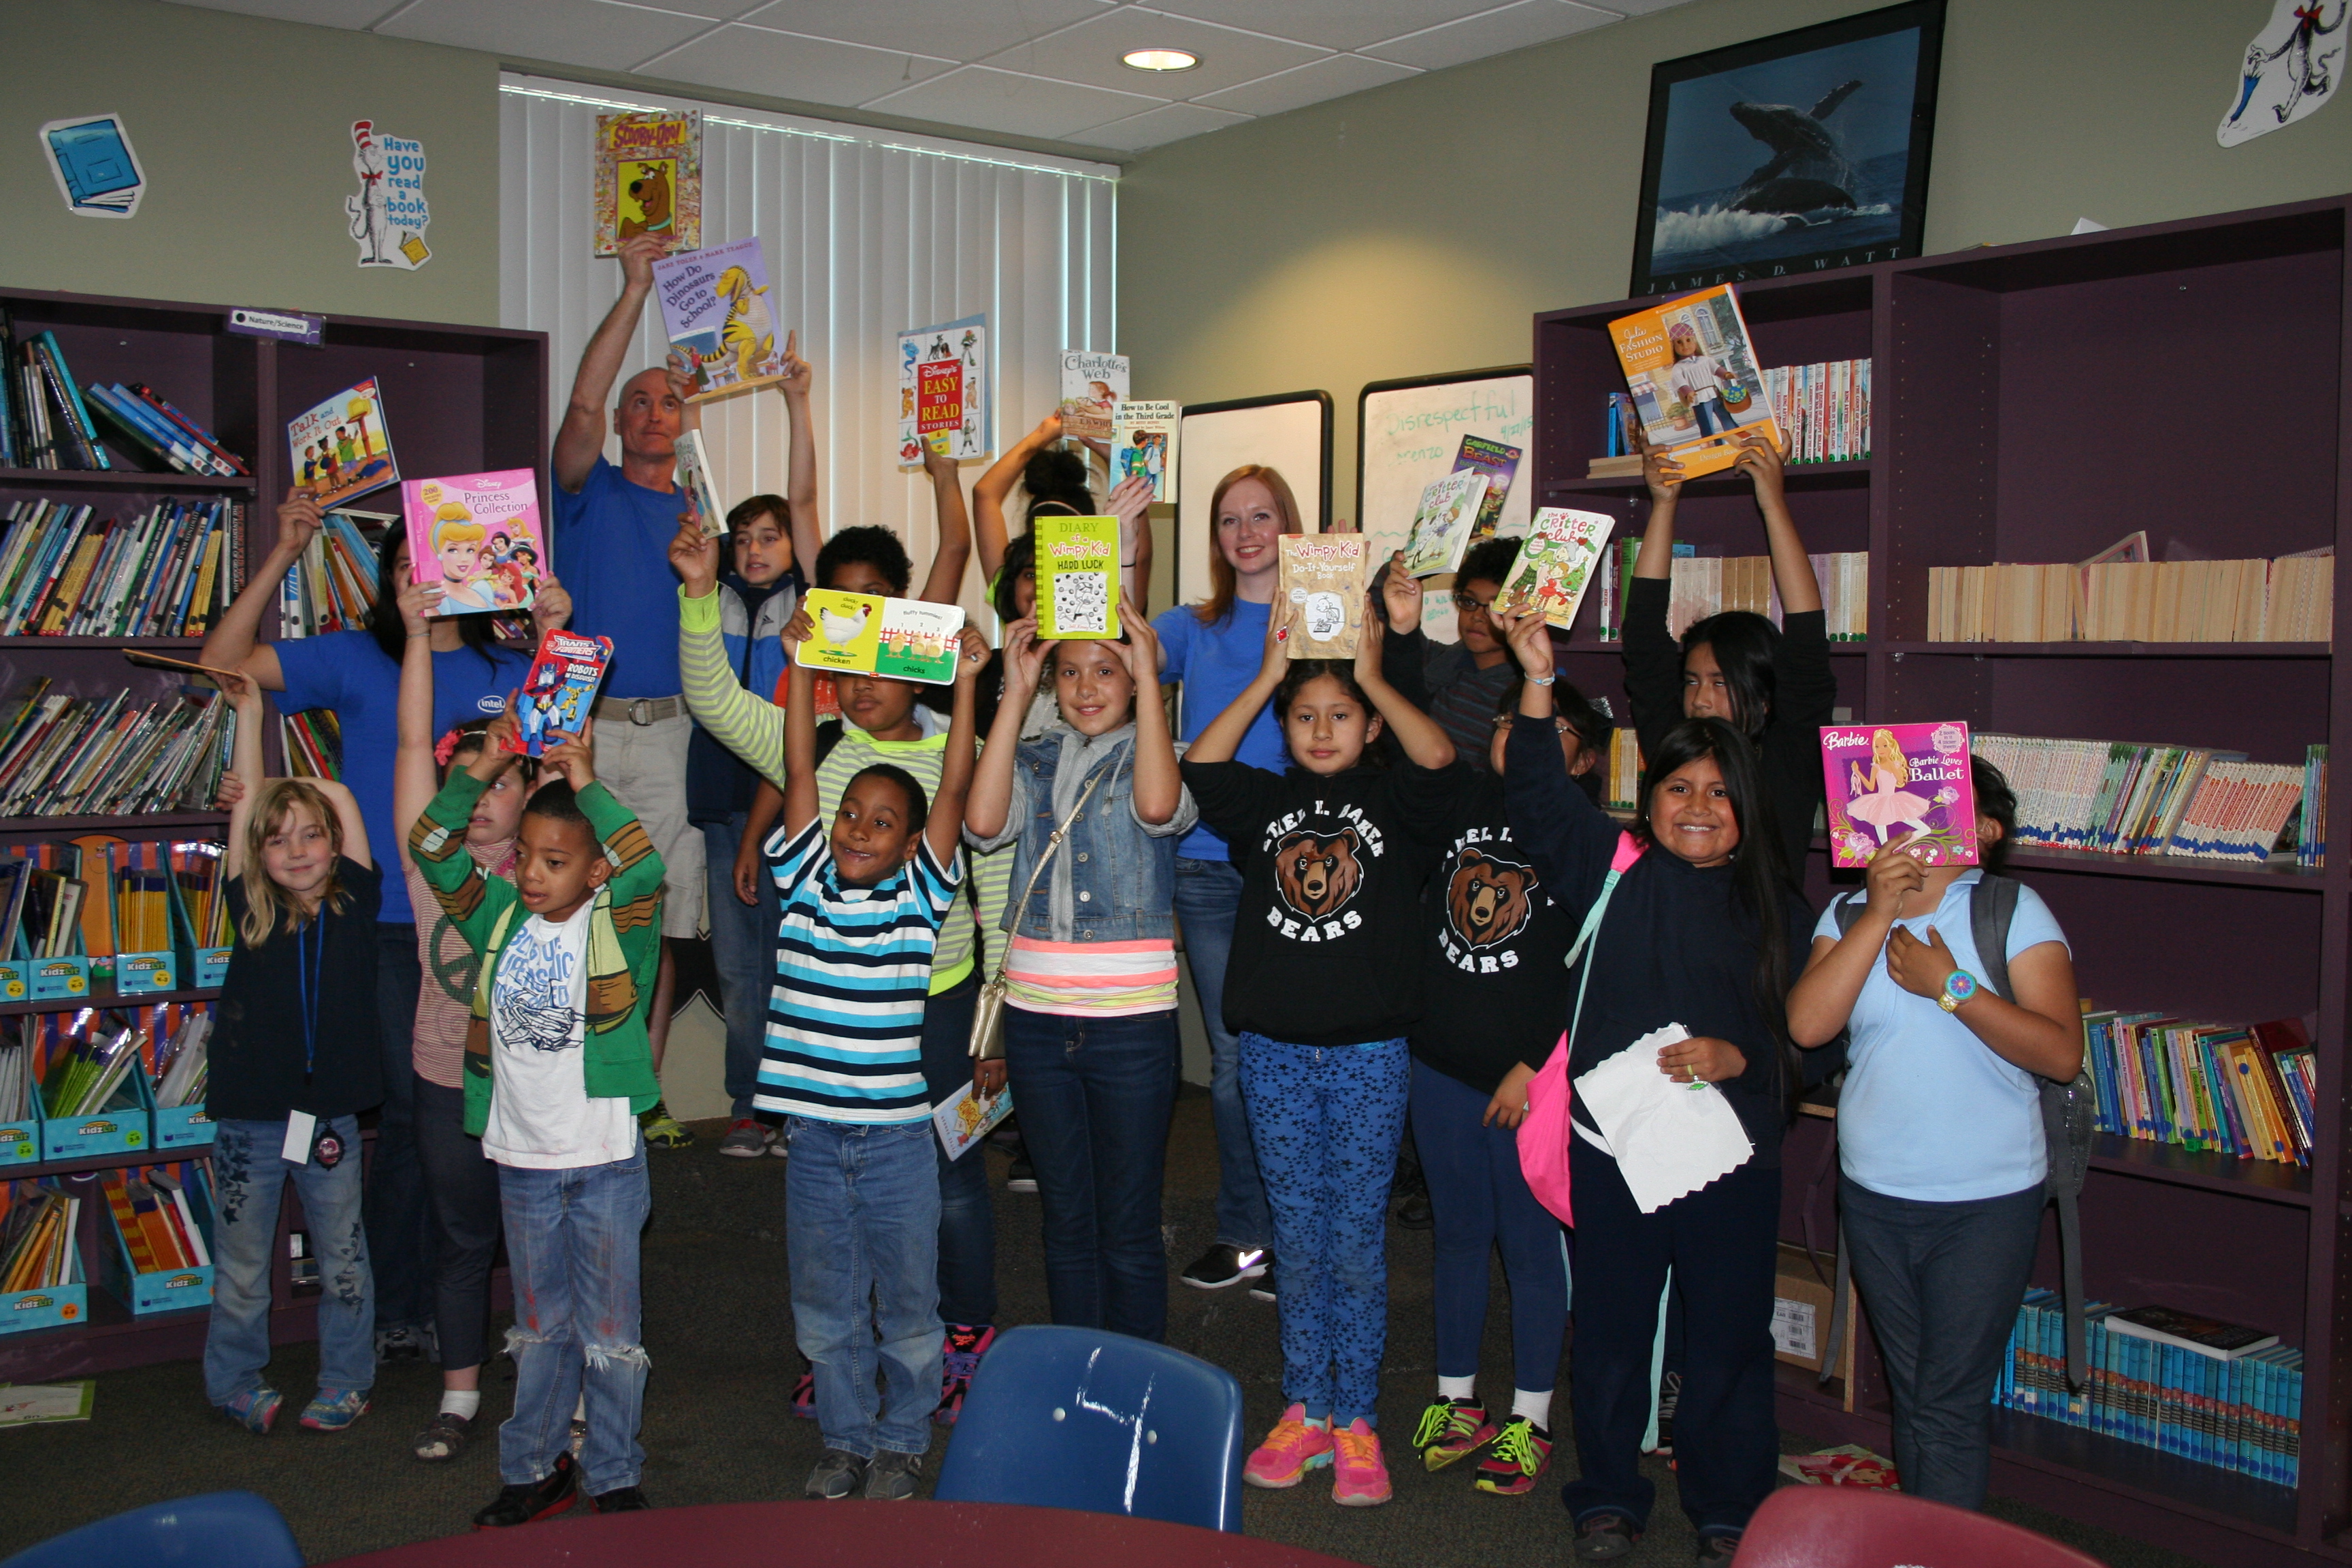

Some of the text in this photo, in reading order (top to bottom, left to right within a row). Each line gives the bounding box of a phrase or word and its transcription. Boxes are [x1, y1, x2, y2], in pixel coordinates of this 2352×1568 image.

[385, 137, 419, 151] Have
[387, 156, 424, 175] you
[388, 175, 421, 189] read
[399, 191, 406, 199] a
[387, 197, 425, 213] book
[387, 215, 427, 229] today?
[657, 262, 674, 270] JANE
[705, 249, 724, 259] MARK
[663, 265, 702, 293] How Do
[1648, 271, 1744, 295] JAMES
[1814, 248, 1900, 269] WATT
[666, 272, 715, 306] Dinosaurs
[679, 289, 707, 312] Go to
[681, 295, 716, 328] School?
[249, 316, 304, 329] Nature/Science
[1620, 334, 1663, 353] FASHION
[1626, 345, 1663, 362] STUDIO
[1064, 355, 1127, 373] Charlotte's
[1081, 369, 1111, 380] Web
[924, 377, 958, 395] EASY
[934, 394, 947, 404] TO
[922, 404, 960, 422] READ
[290, 407, 333, 437] Talk and
[314, 427, 322, 436] It
[325, 416, 342, 429] Out
[921, 421, 959, 430] STORIES
[1463, 446, 1507, 467] BEAST
[464, 493, 509, 504] Princess
[474, 502, 527, 514] Collection
[1060, 523, 1098, 532] DIARY
[1049, 541, 1111, 559] Wimpy Kid
[1296, 543, 1337, 561] Wimpy
[1340, 541, 1360, 558] Kid
[1058, 560, 1104, 570] HARD LUCK
[1292, 562, 1356, 573] Do-It-Yourself
[823, 656, 851, 665] chicken
[567, 663, 599, 676] ROBOTS
[903, 666, 925, 674] chicks
[1823, 731, 1868, 751] Barbie
[1909, 753, 1963, 768] Barbie Loves
[1910, 767, 1964, 782] Ballet
[1267, 906, 1362, 942] BEARS
[1438, 928, 1519, 973] BEARS
[41, 966, 80, 977] KidzLit
[127, 961, 165, 971] KidzLit
[79, 1124, 117, 1136] KidzLit
[165, 1277, 203, 1289] KidzLit
[14, 1297, 54, 1311] KidzLit
